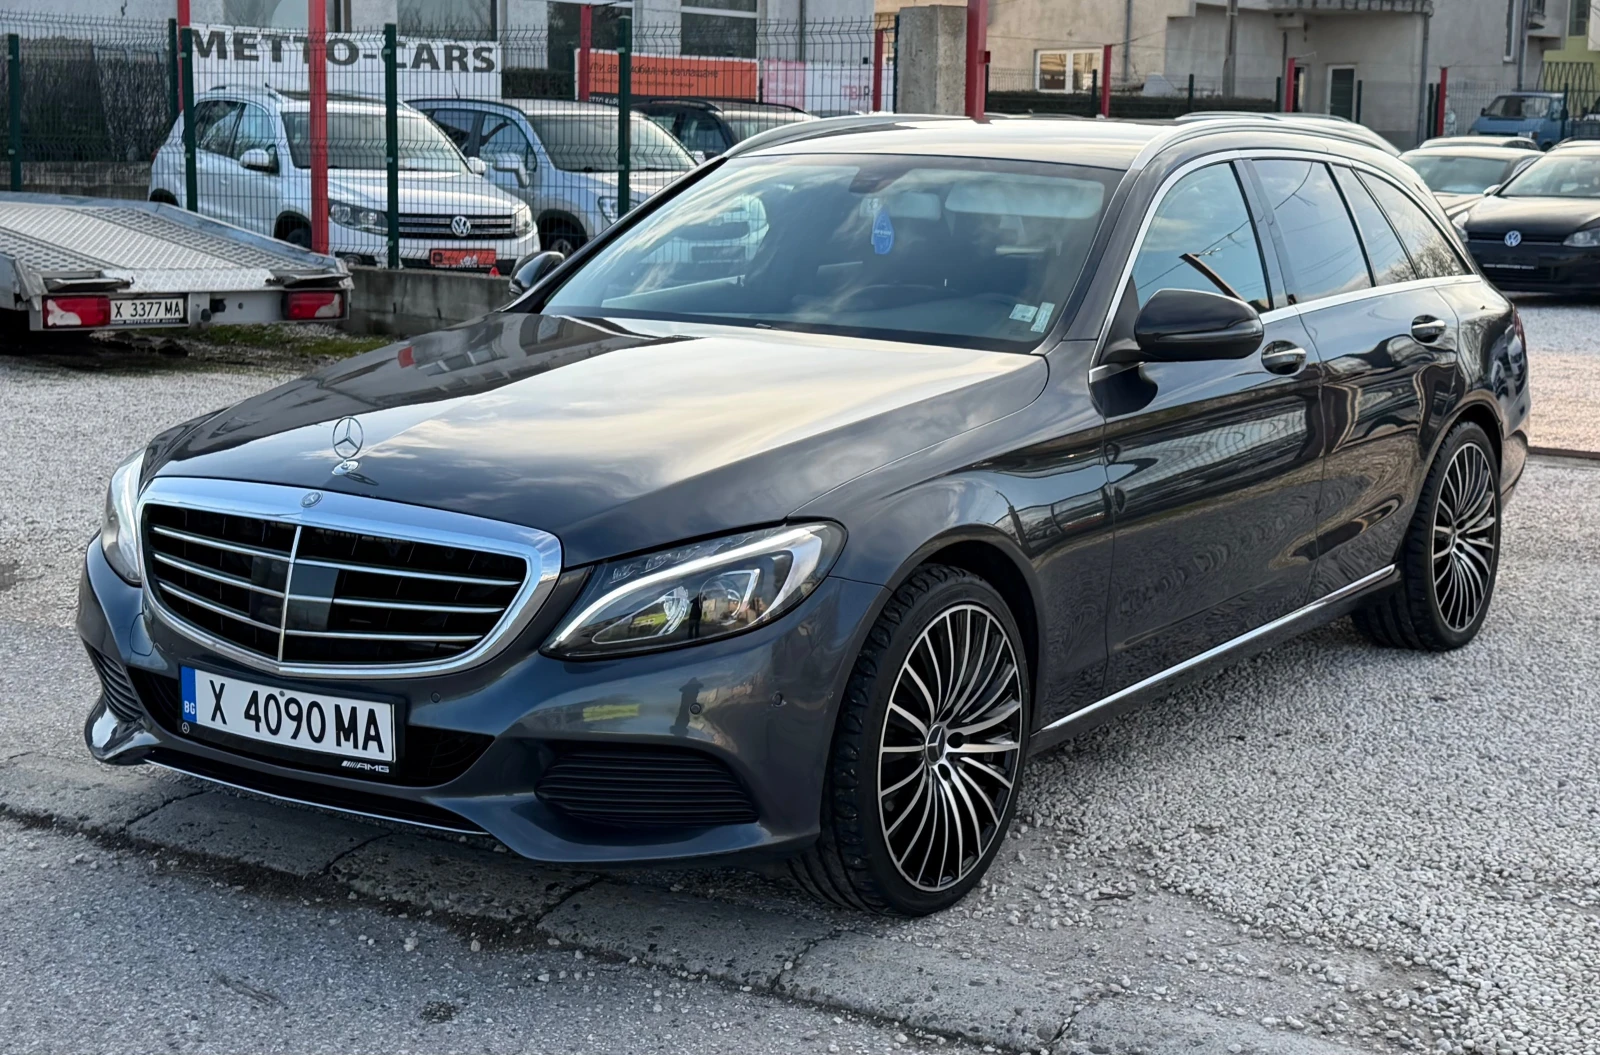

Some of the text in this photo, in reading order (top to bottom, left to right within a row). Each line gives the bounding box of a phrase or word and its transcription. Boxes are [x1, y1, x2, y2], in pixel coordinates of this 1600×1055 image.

[114, 300, 181, 318] X 3377 MA
[184, 700, 196, 714] BG
[209, 679, 385, 754] X 4090 MA
